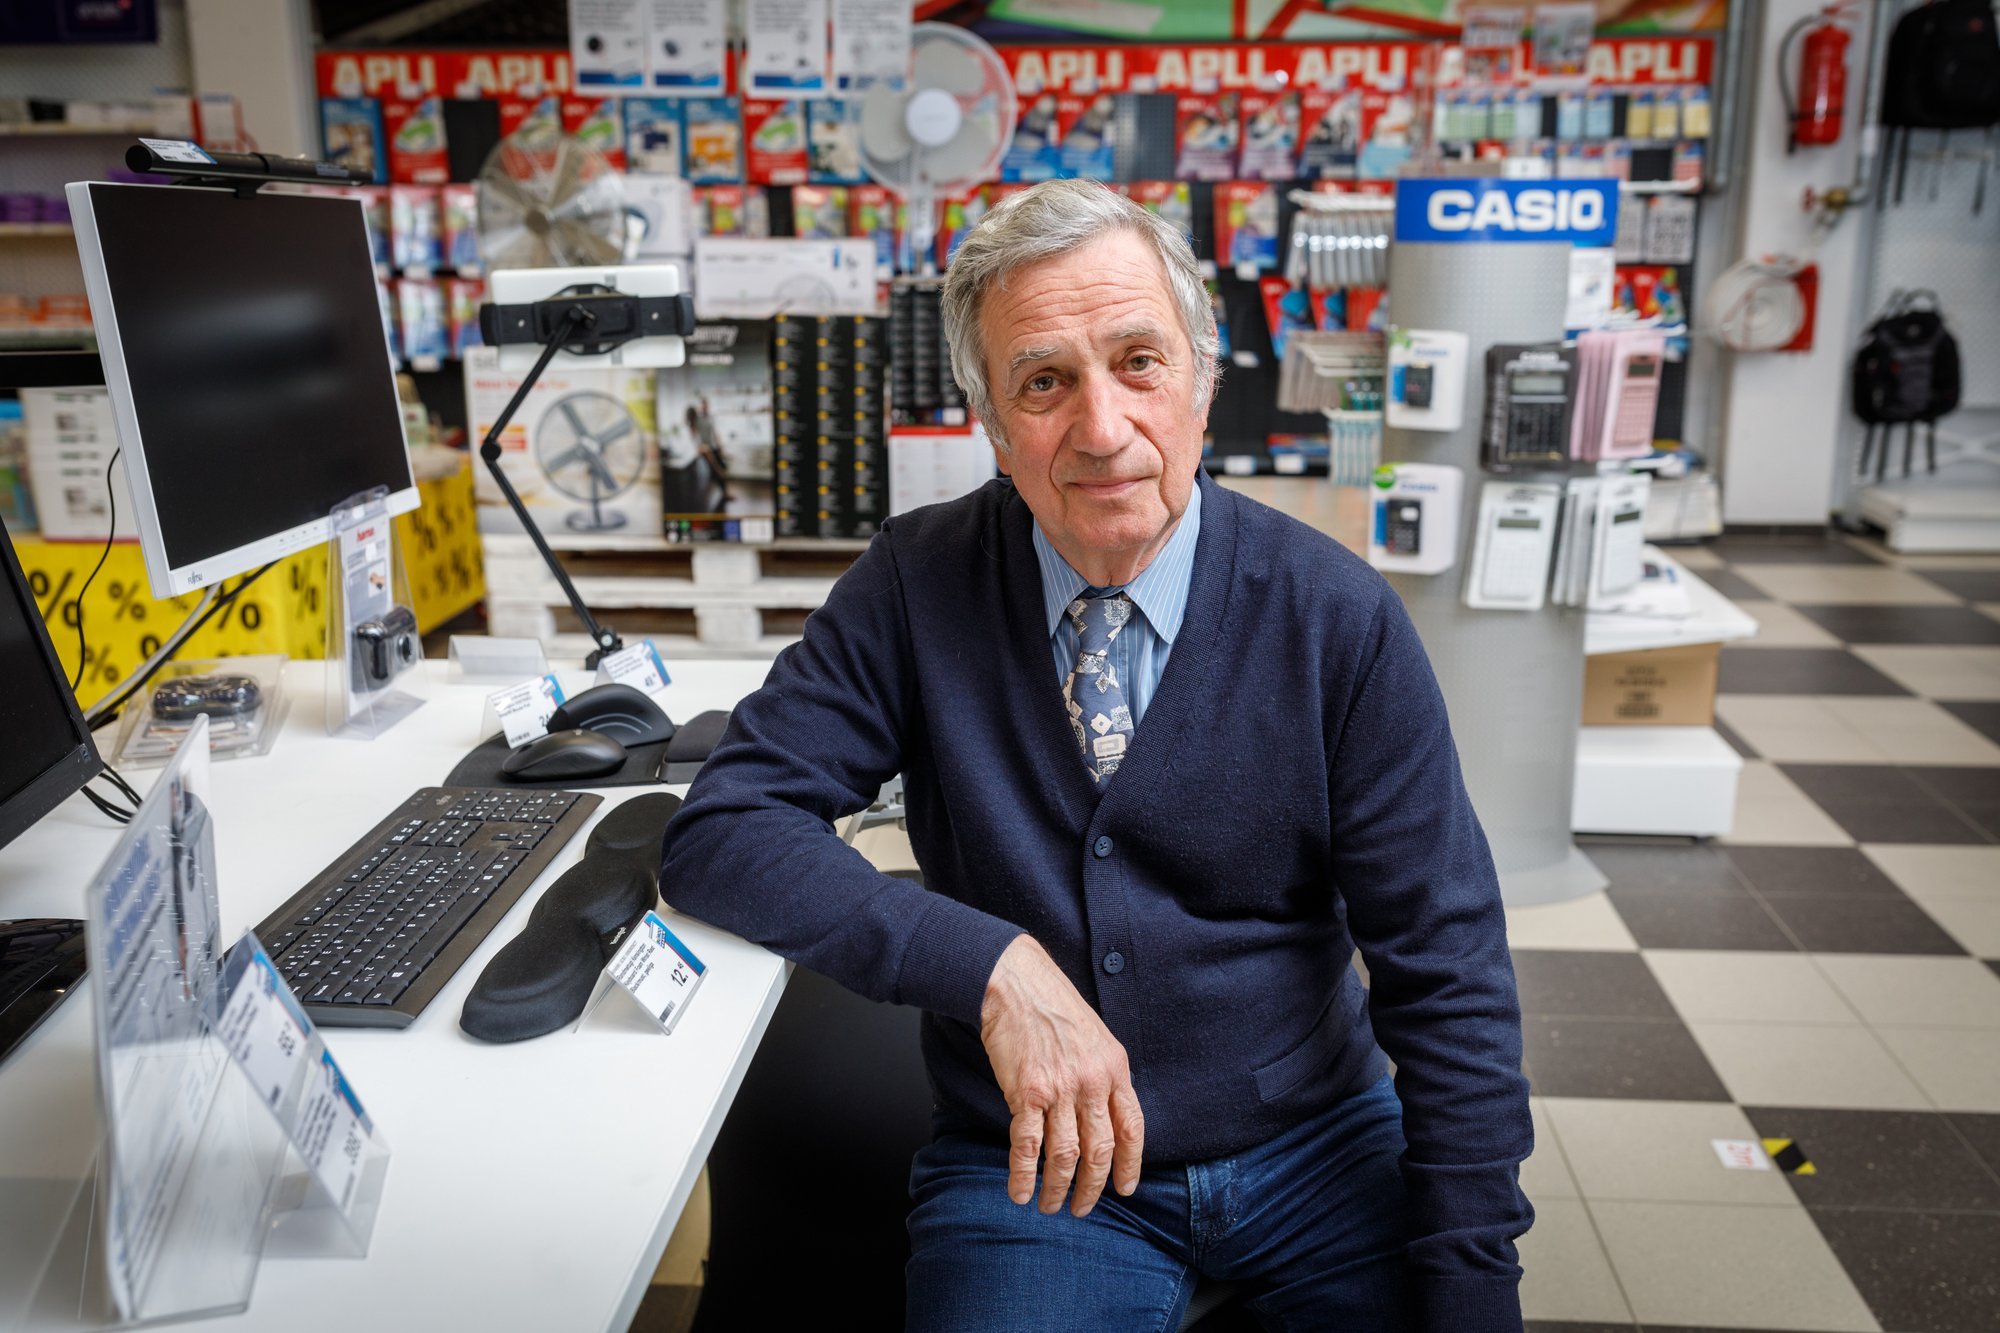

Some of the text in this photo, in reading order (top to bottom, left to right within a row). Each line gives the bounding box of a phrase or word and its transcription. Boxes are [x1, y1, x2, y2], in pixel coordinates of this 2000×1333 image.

[332, 56, 435, 94] APLI
[465, 55, 571, 95] APLI
[1016, 50, 1123, 89] APLI
[1156, 49, 1267, 89] APLI
[1295, 46, 1408, 84] APLI
[1586, 42, 1699, 80] APLI
[1427, 188, 1605, 232] CASIO
[29, 571, 82, 628] %
[108, 582, 147, 621] %
